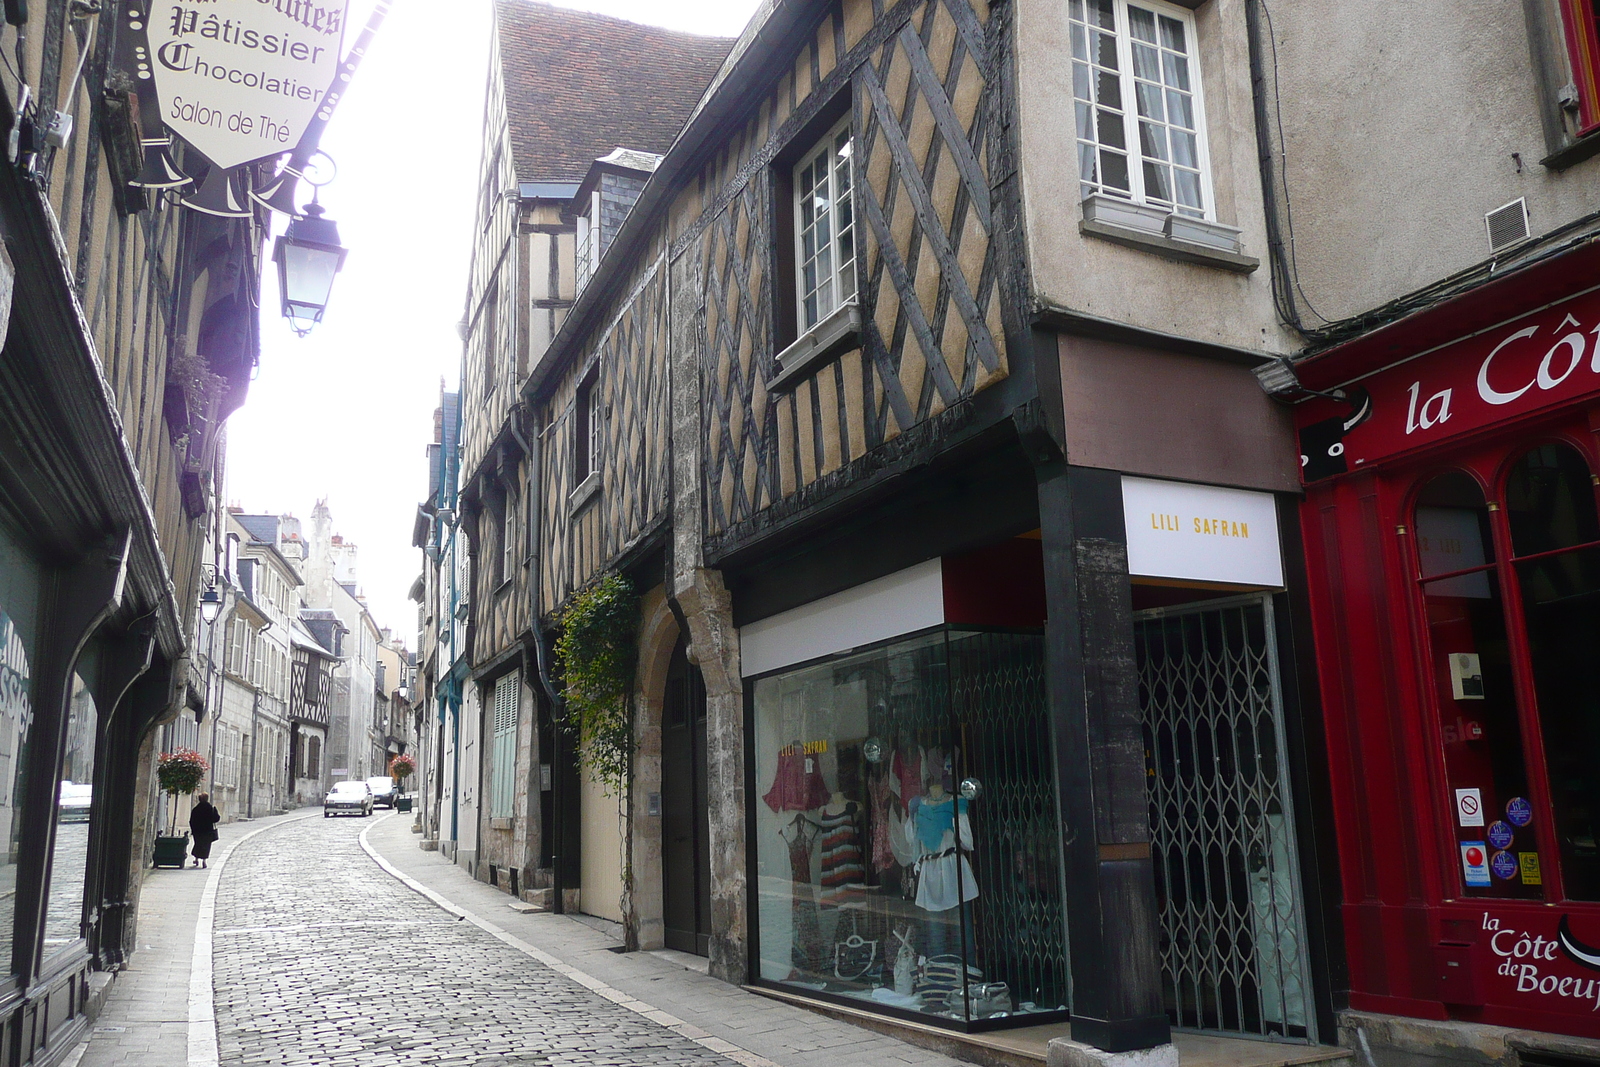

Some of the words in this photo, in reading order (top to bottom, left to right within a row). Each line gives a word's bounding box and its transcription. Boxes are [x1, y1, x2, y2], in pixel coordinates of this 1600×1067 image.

[169, 6, 324, 64] Pâtissier
[157, 40, 323, 102] Chocolatier
[171, 96, 222, 128] Salon
[228, 111, 253, 135] de
[259, 115, 290, 143] Thé
[1406, 381, 1452, 434] la
[1151, 513, 1179, 531] LILI
[1193, 517, 1249, 539] SAFRAN
[803, 740, 827, 755] SAFRAN
[1482, 912, 1500, 931] la
[1491, 929, 1559, 961] Côte
[1497, 957, 1519, 977] de
